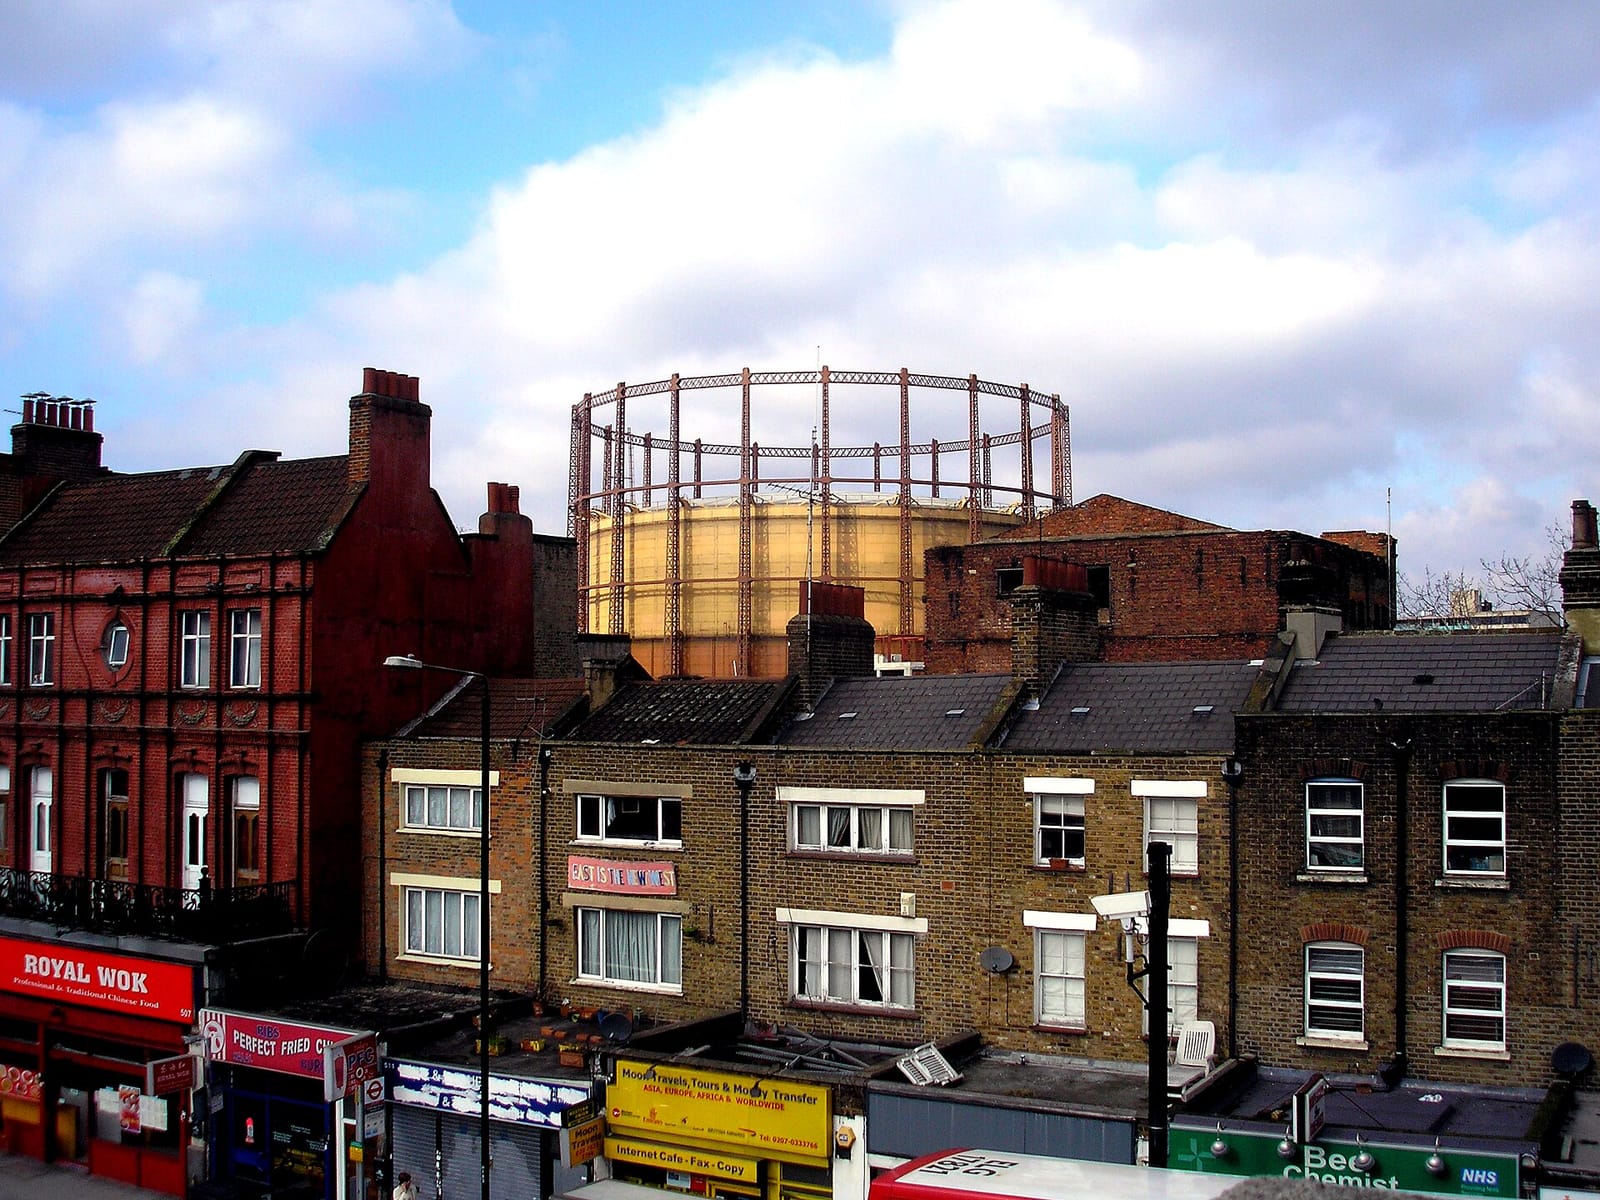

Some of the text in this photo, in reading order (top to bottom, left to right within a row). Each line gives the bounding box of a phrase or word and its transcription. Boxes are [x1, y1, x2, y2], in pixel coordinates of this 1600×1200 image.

[572, 863, 594, 881] EAST
[597, 865, 607, 884] IS
[608, 868, 624, 886] THE
[24, 954, 148, 994] ROYAL WOK
[13, 976, 55, 990] Professional
[66, 986, 106, 999] Traditional
[107, 993, 138, 1006] Chinese
[139, 999, 159, 1009] Food
[233, 1029, 276, 1056] PERFECT
[281, 1037, 311, 1056] FRIED
[257, 1025, 280, 1039] RIBS
[347, 1046, 375, 1070] PFC
[691, 1078, 719, 1091] Tours
[722, 1081, 730, 1092] &
[733, 1083, 769, 1100] Moy
[772, 1089, 818, 1105] Transfer
[697, 1092, 723, 1102] AFRICA
[735, 1096, 785, 1111] WORLDWIDE
[572, 1132, 601, 1150] Travels
[575, 1124, 598, 1138] Moon
[616, 1144, 658, 1160] Internet
[660, 1151, 683, 1163] Cafe
[690, 1156, 710, 1168] Fax
[717, 1160, 744, 1175] Copy
[919, 1154, 986, 1175] 17821
[1462, 1168, 1497, 1184] NHS
